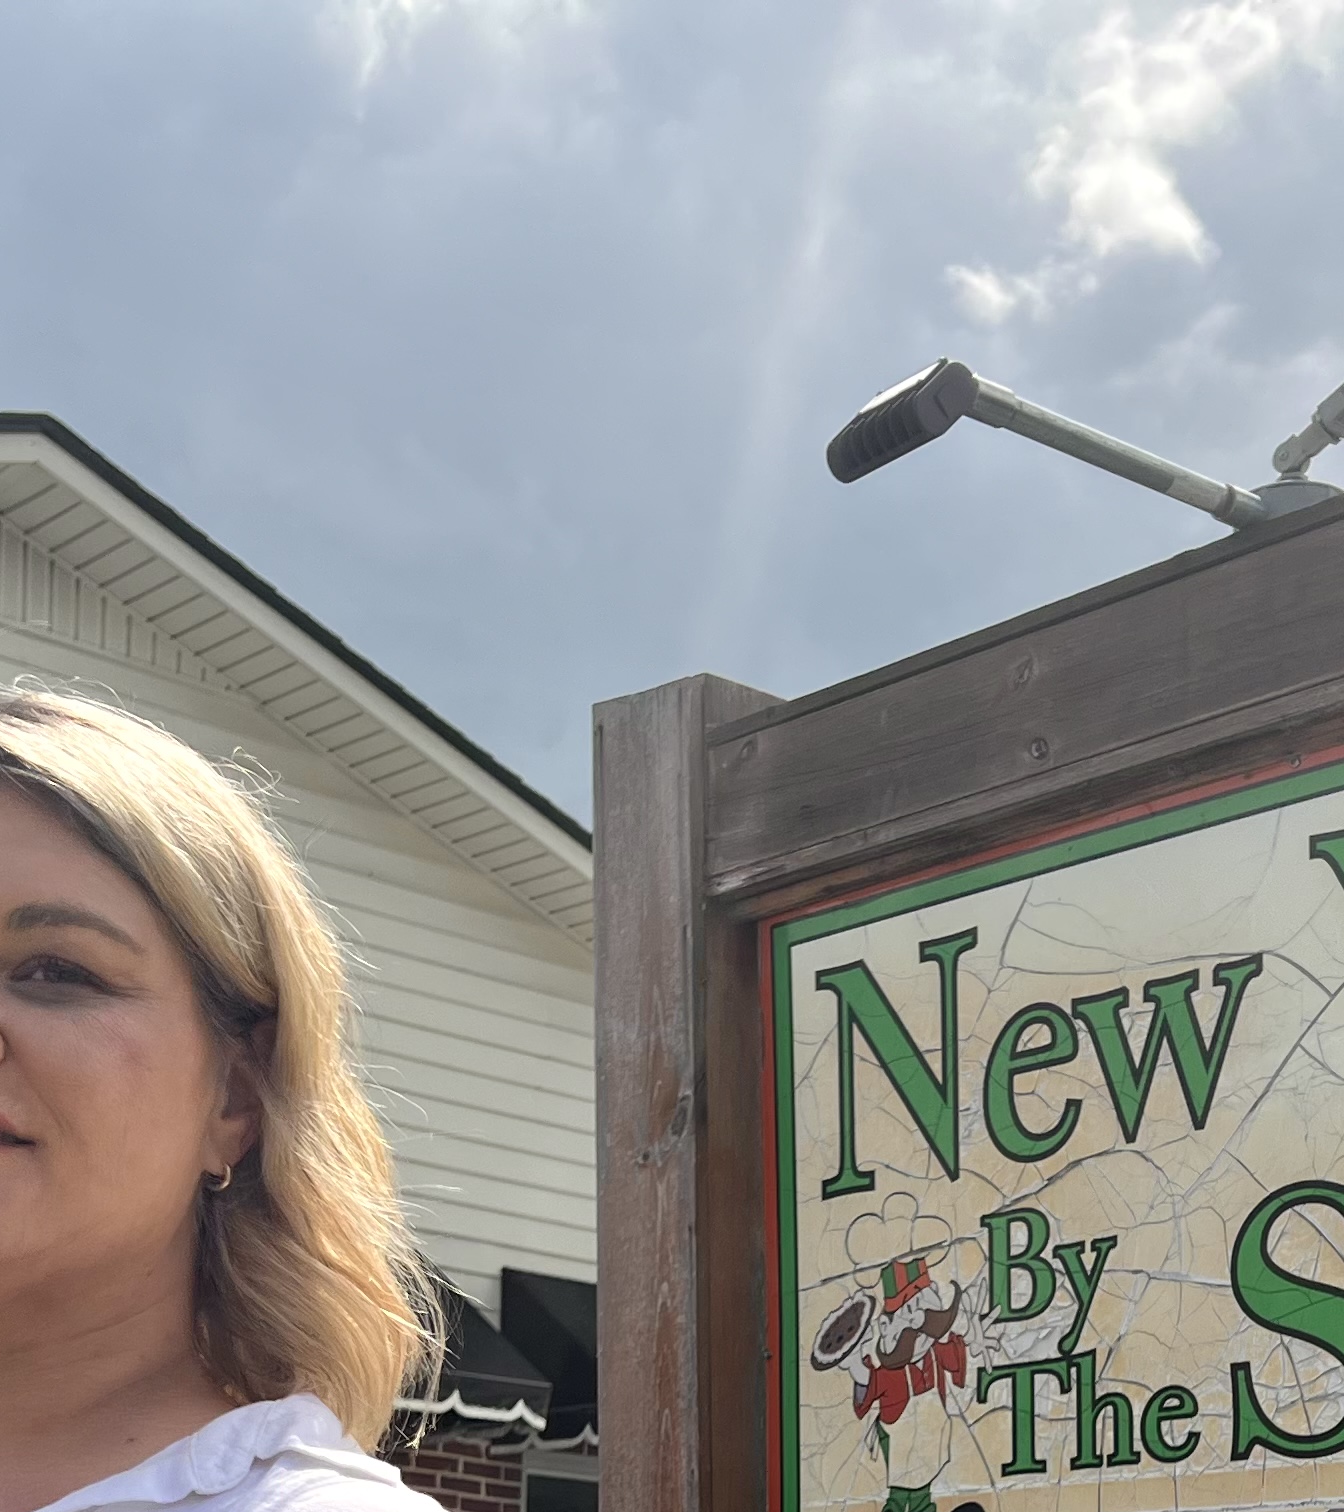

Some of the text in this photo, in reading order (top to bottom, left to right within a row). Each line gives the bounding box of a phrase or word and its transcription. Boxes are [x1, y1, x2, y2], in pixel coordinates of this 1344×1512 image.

[815, 926, 1263, 1201] New
[980, 1207, 1118, 1355] By
[976, 1348, 1201, 1477] The
